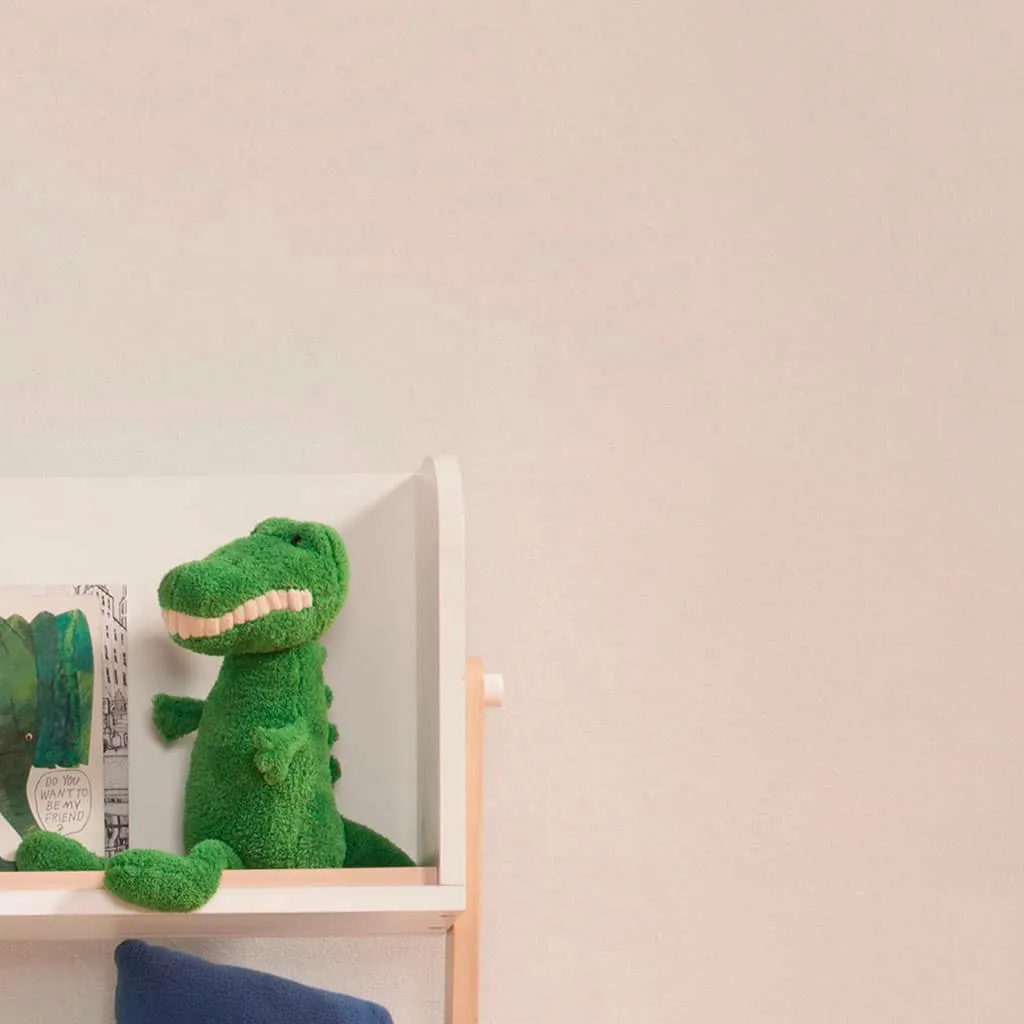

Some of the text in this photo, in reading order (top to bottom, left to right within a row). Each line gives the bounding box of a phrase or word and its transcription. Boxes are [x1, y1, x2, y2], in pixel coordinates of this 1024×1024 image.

[45, 775, 80, 787] DO YOU
[40, 788, 89, 800] WANT TO
[46, 800, 81, 811] BE MY
[45, 811, 84, 824] FRIEND
